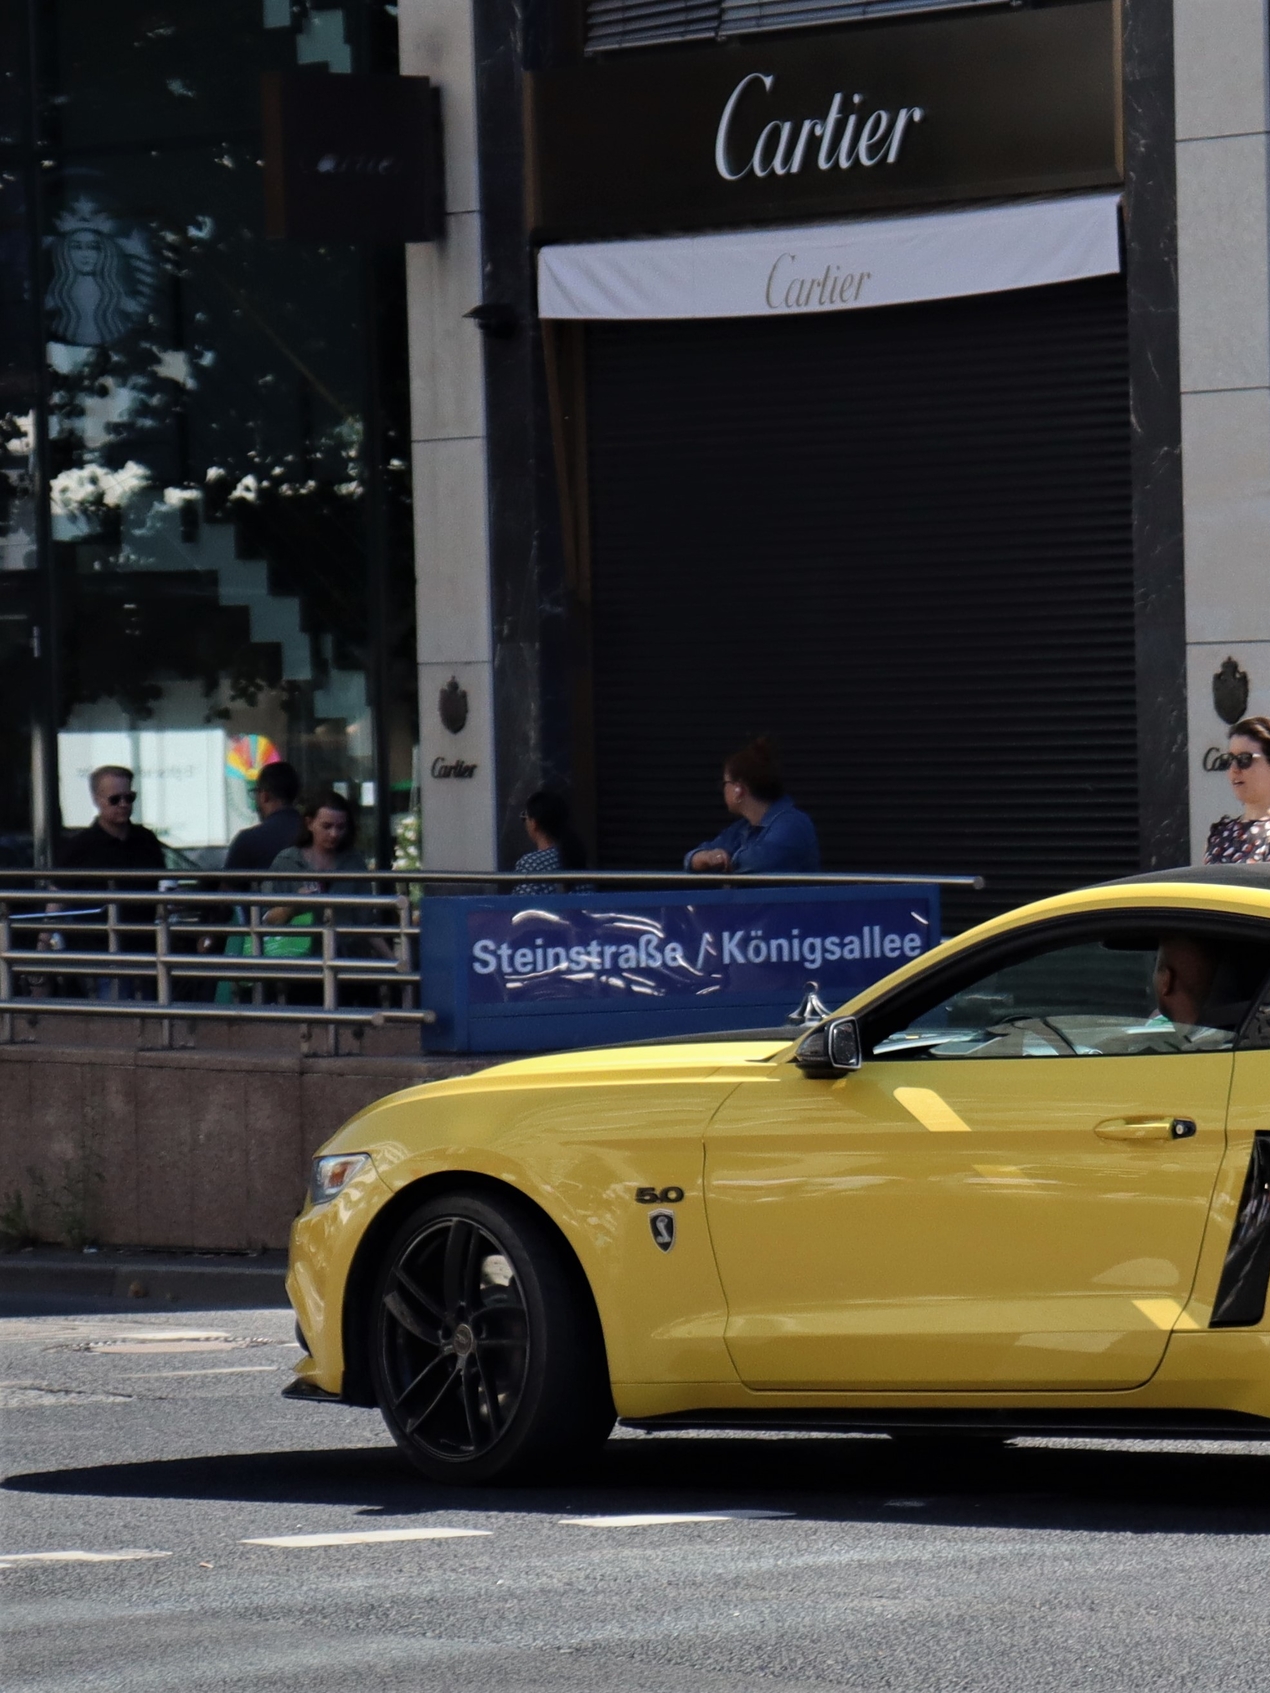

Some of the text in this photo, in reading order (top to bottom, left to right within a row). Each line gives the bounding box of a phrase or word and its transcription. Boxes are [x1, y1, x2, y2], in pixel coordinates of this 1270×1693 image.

[715, 72, 924, 180] Cartier
[765, 252, 871, 309] Cartier
[430, 756, 478, 779] Cartier
[472, 933, 684, 974] Steinstraße
[721, 924, 922, 970] Königsallee
[635, 1186, 685, 1204] 5.0
